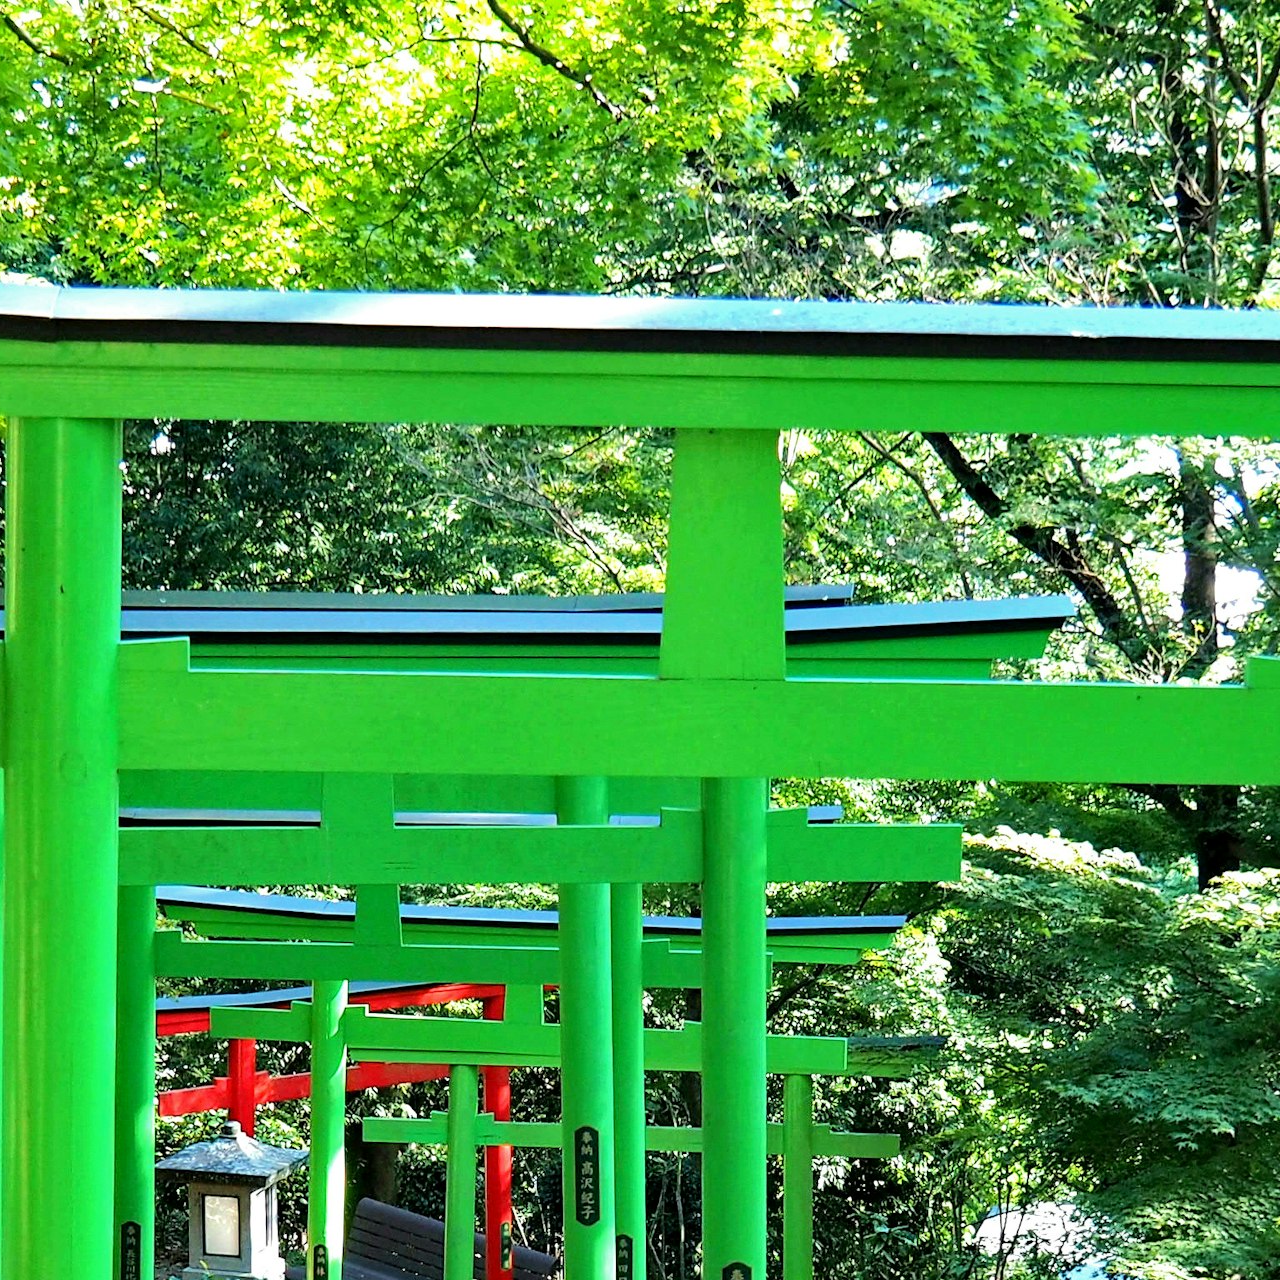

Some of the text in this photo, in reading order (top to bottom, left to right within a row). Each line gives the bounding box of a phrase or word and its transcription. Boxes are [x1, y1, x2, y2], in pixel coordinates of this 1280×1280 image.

[580, 1131, 595, 1219] 奉納 高沢紀子
